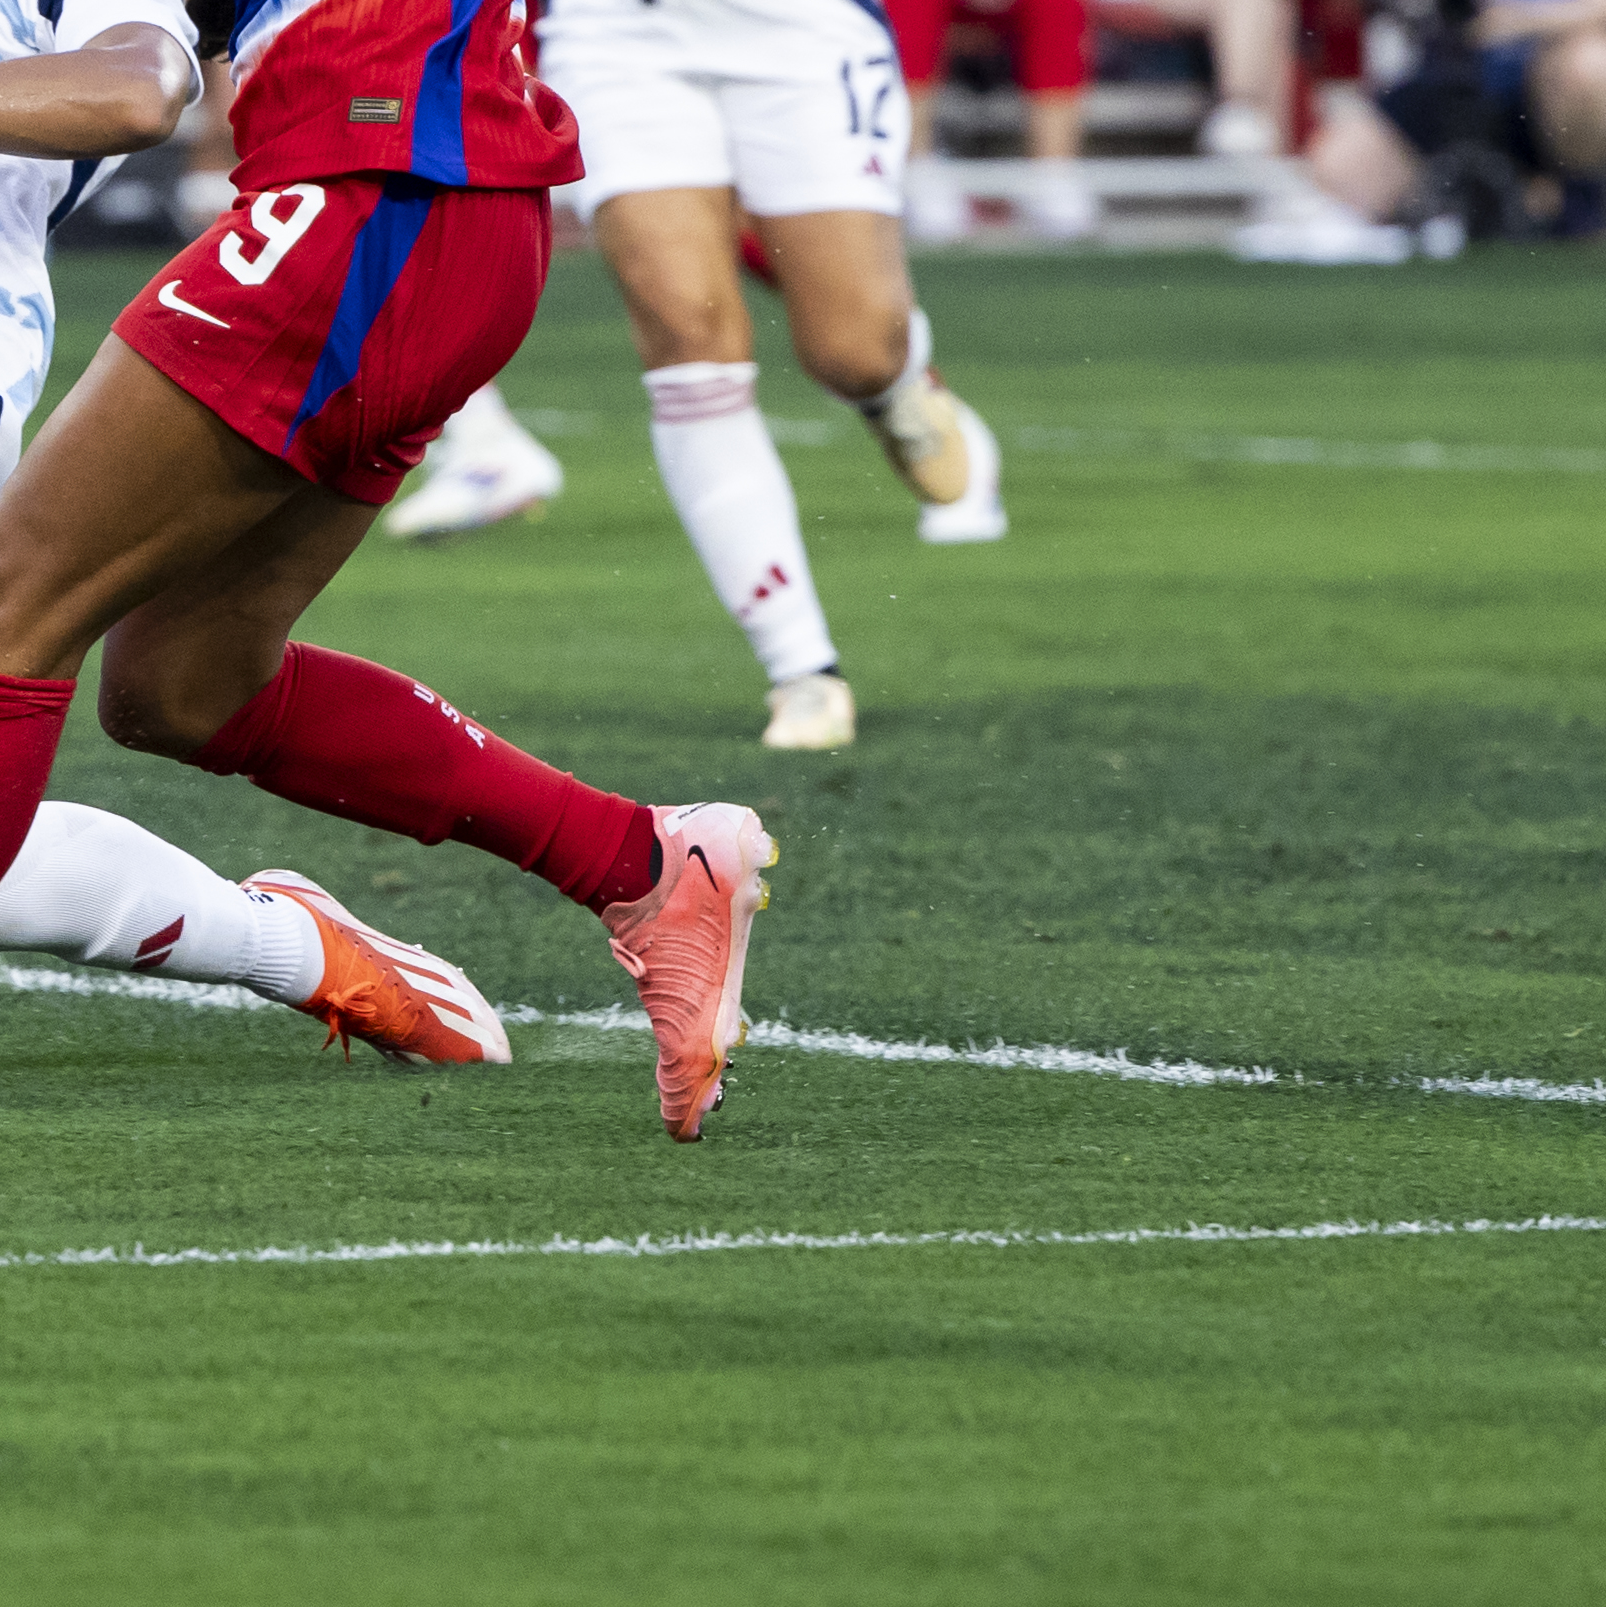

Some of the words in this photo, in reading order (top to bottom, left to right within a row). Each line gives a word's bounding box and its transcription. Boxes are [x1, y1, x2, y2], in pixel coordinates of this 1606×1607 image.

[840, 56, 894, 139] 12
[218, 183, 326, 286] 9
[413, 683, 486, 750] USA
